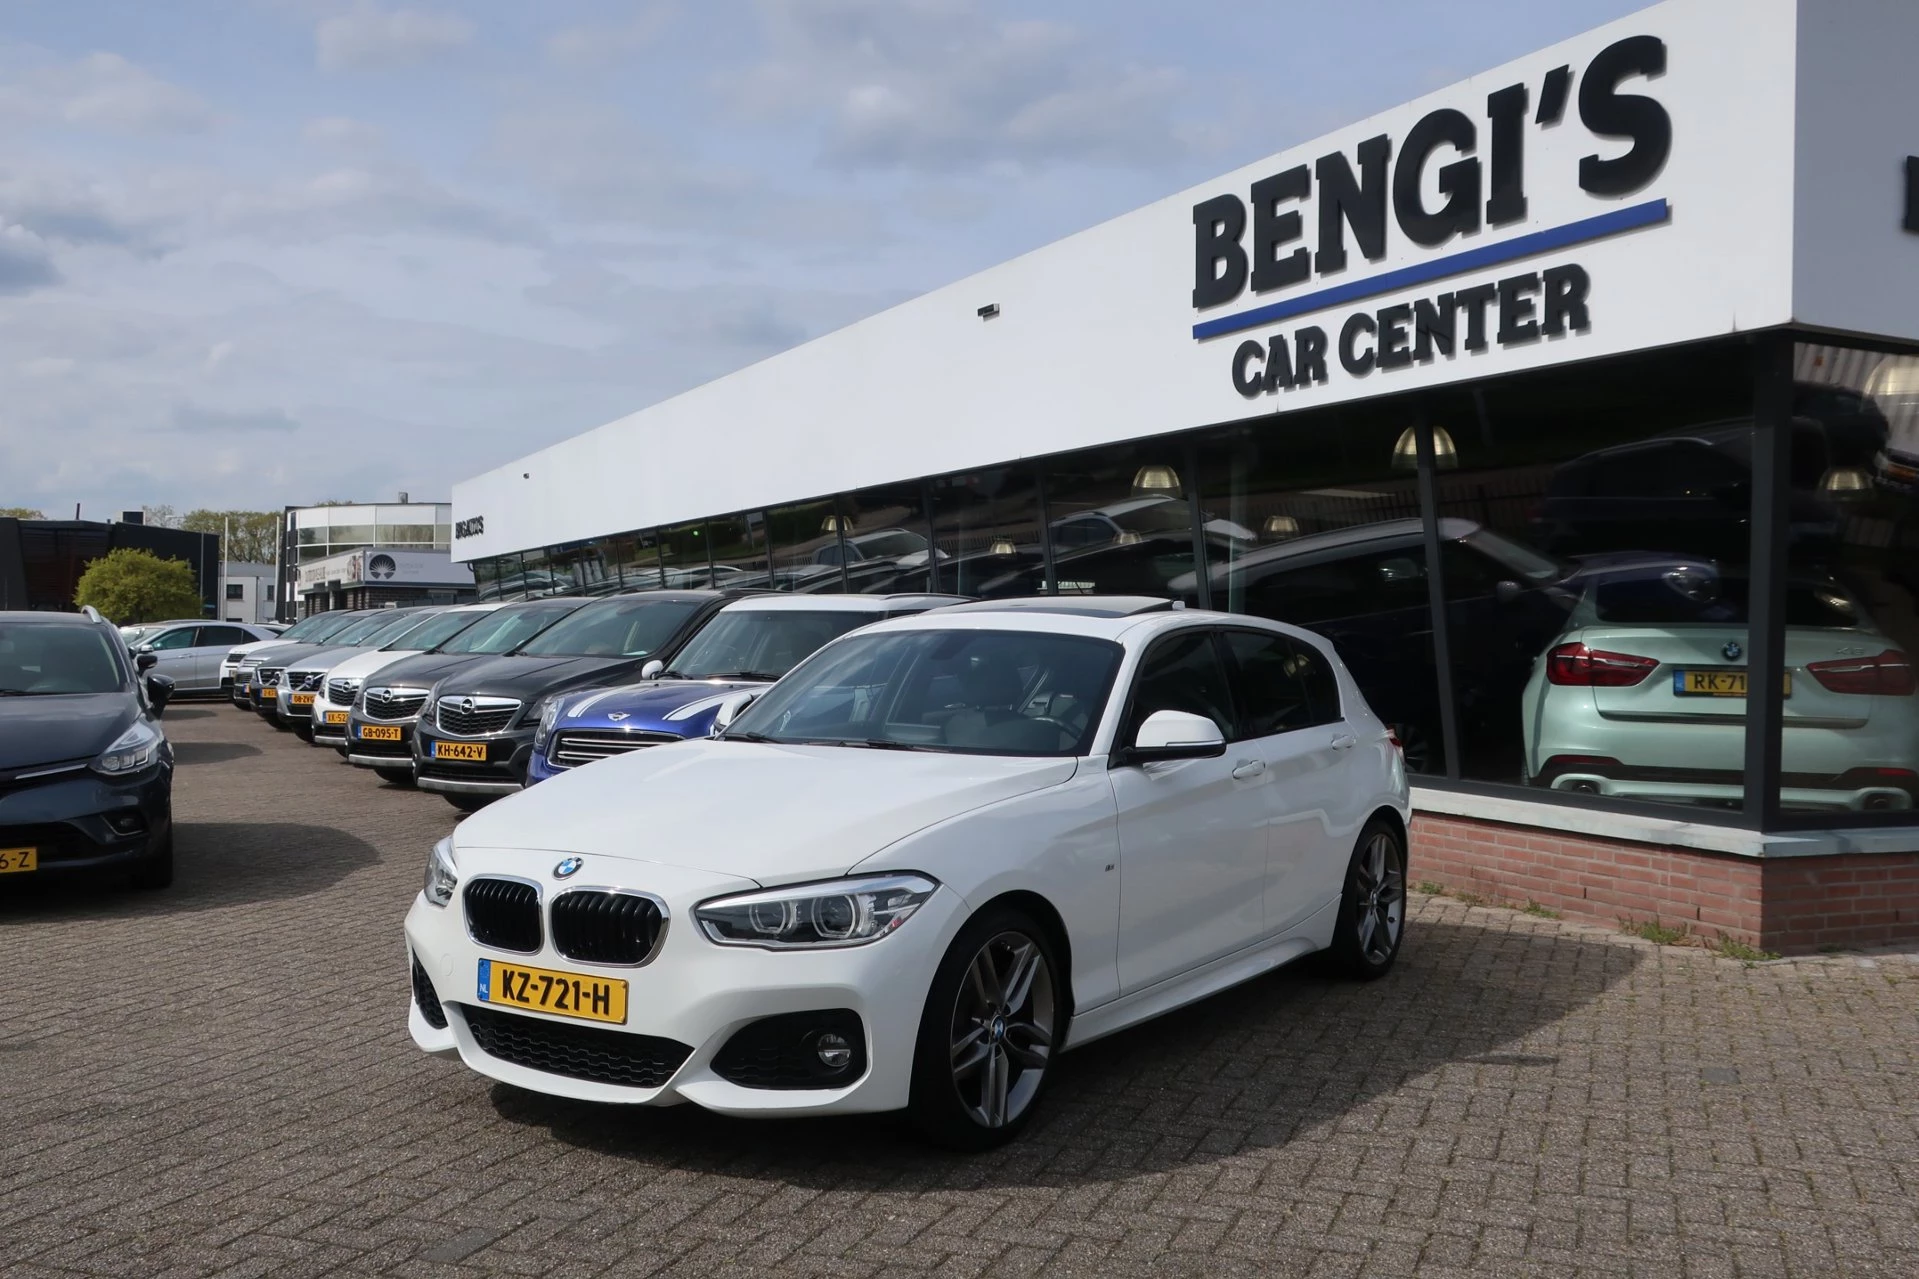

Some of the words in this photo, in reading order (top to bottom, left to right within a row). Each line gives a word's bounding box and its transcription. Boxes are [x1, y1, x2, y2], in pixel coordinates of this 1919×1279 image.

[1192, 34, 1672, 309] BENGI'S
[1232, 325, 1327, 398] CAR
[1338, 263, 1591, 376] CENTER
[362, 729, 399, 739] GB-095-T
[437, 743, 484, 758] KH-642-V
[502, 969, 610, 1016] KZ-721-H
